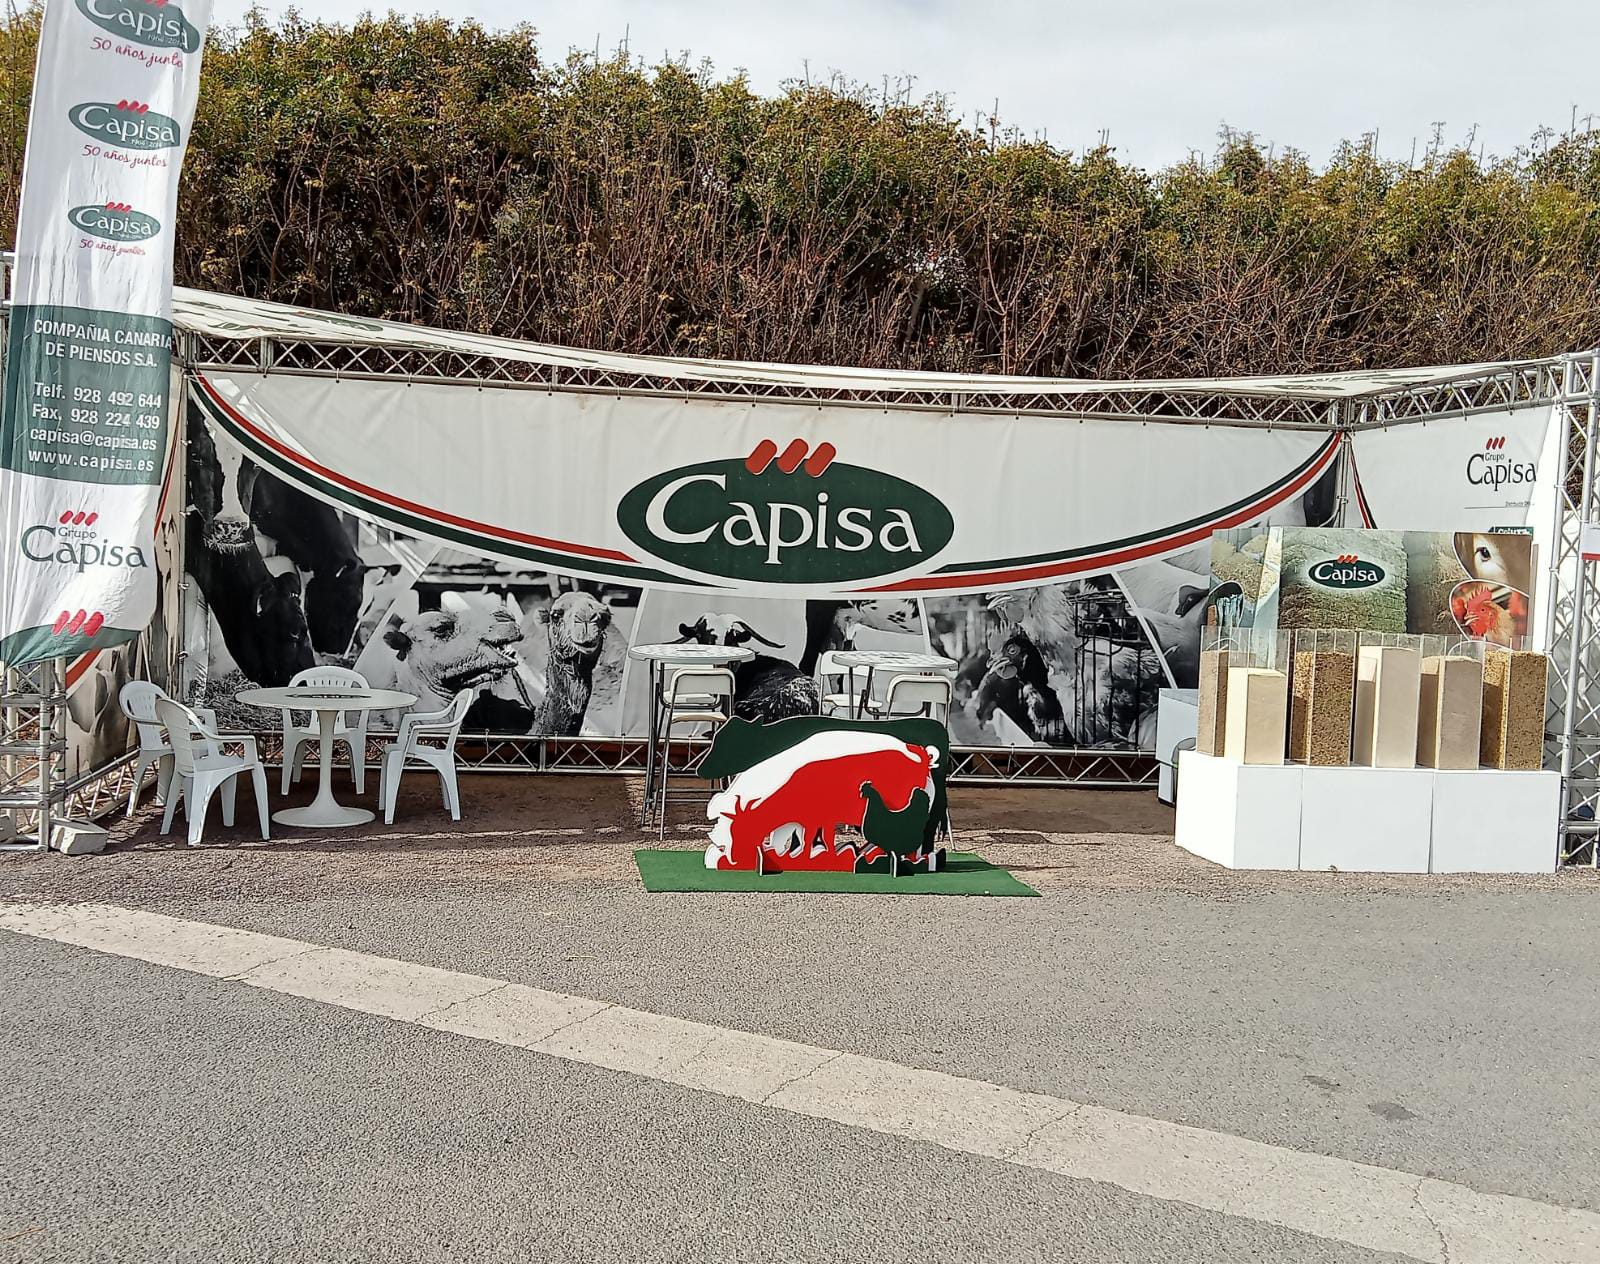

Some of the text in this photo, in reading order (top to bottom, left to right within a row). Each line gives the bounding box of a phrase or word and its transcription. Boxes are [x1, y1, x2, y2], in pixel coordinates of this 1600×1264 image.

[90, 36, 112, 51] 50
[115, 44, 147, 60] años
[78, 105, 175, 143] Capisa
[82, 144, 167, 169] 50 años juntos
[75, 208, 152, 235] Capisa
[79, 238, 94, 249] 50
[96, 241, 116, 252] años
[33, 319, 173, 350] COMPAÑIA CANARIA
[45, 341, 158, 367] DE PIENSOS S.A.
[34, 381, 162, 409] Telf. 928 492 644
[70, 408, 99, 425] 928
[105, 411, 132, 427] 224
[135, 415, 161, 430] 439
[30, 428, 157, 451] capisa@capisa.es
[28, 450, 155, 472] www.capisa.es
[1484, 452, 1505, 463] Grupo
[1466, 453, 1537, 492] Capisa
[645, 474, 923, 565] Capisa
[58, 526, 97, 540] Grupo
[20, 525, 149, 573] Capisa
[1314, 562, 1378, 585] Capisa
